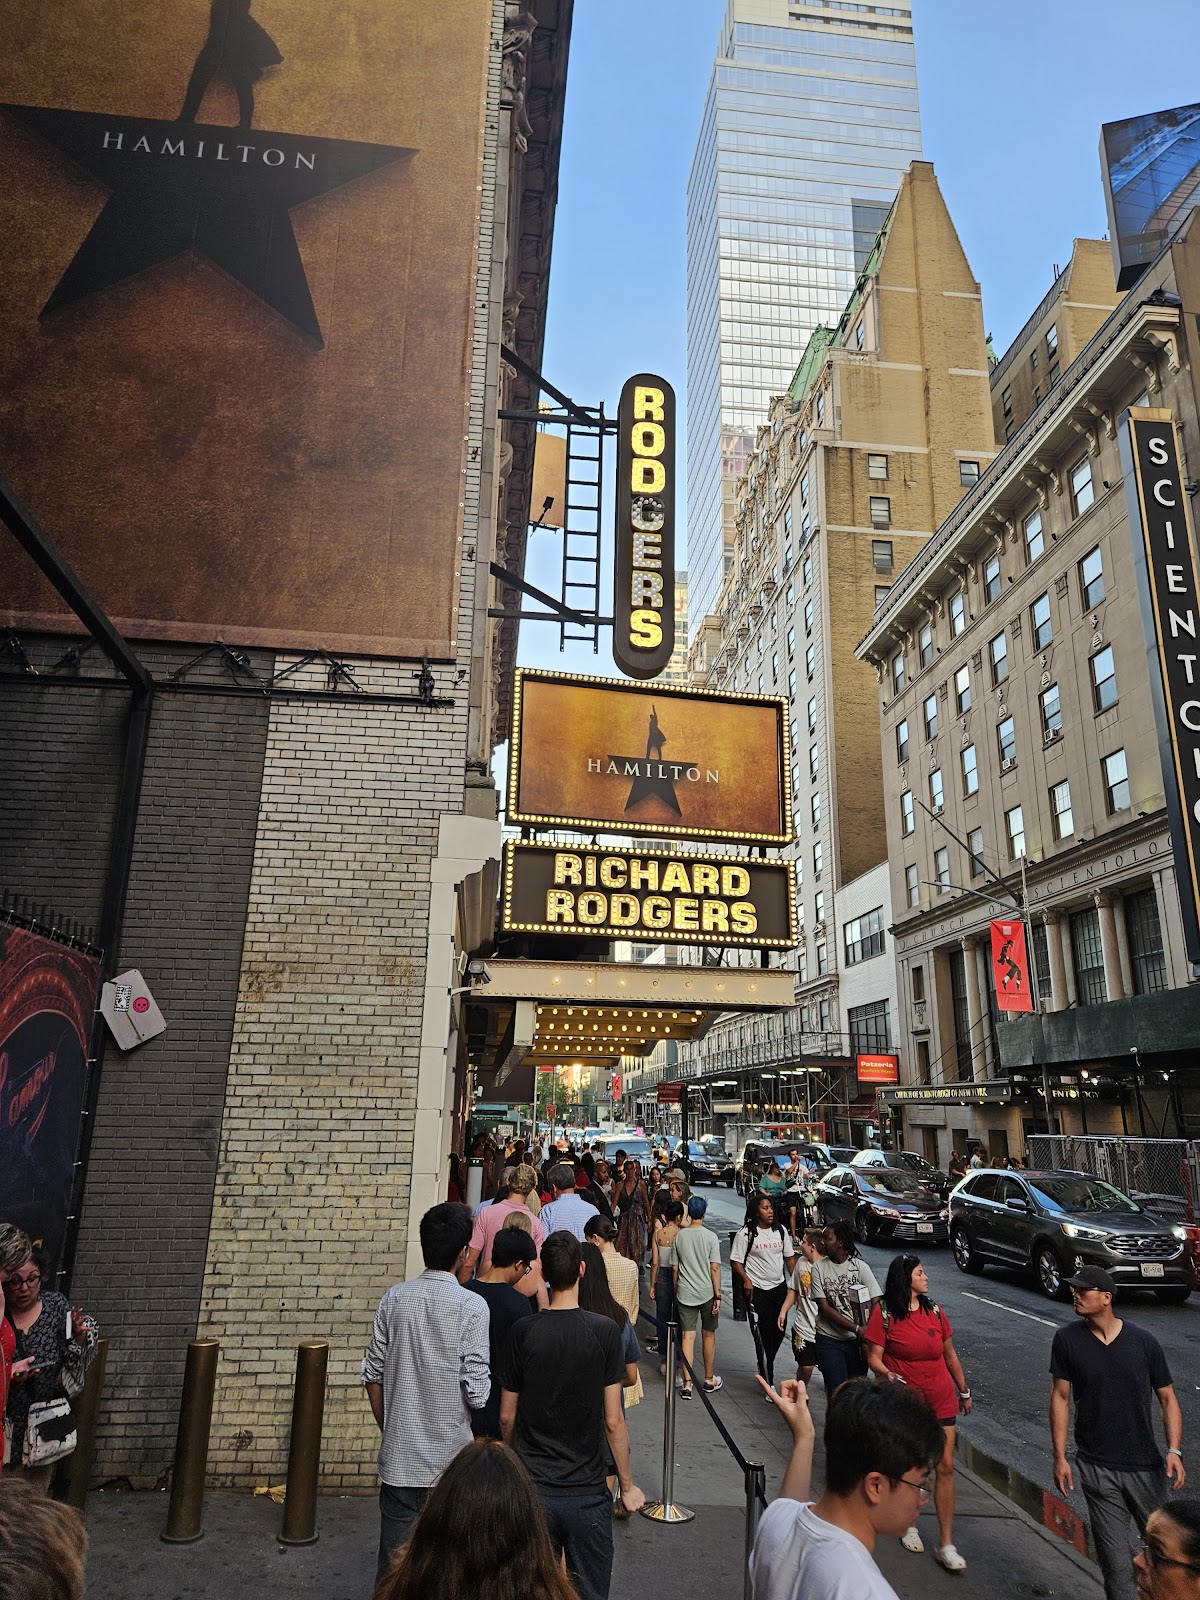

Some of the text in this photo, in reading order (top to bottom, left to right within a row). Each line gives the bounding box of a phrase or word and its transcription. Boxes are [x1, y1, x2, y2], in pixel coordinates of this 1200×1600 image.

[102, 131, 316, 171] HAMILTON
[629, 385, 666, 648] RODGERS
[1149, 437, 1200, 825] SCIENTO
[587, 758, 720, 783] HAMILTON
[553, 853, 751, 897] RICHARD
[546, 889, 758, 935] RODGERS
[914, 917, 965, 943] CHURCH
[971, 1087, 988, 1097] YORK
